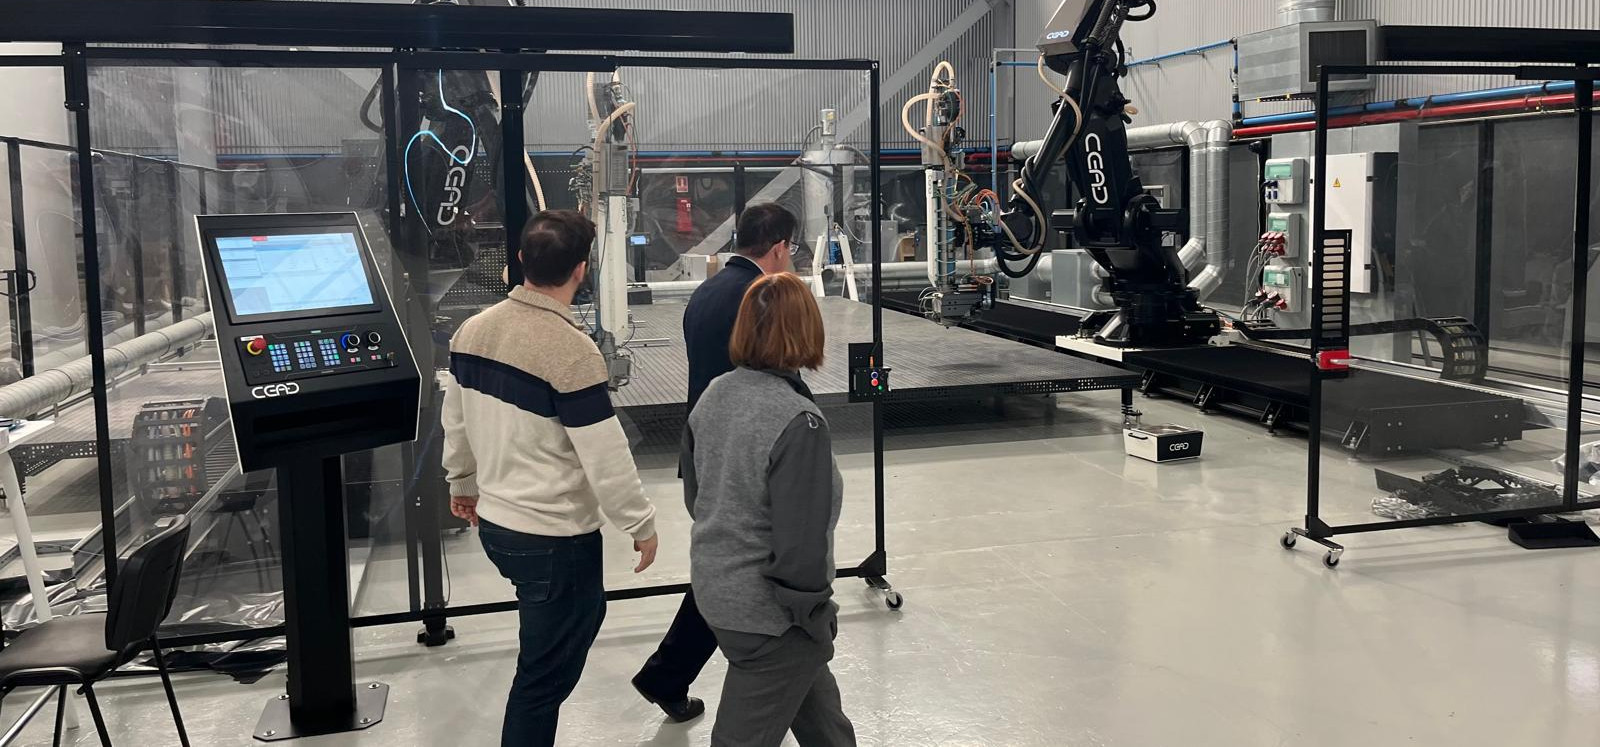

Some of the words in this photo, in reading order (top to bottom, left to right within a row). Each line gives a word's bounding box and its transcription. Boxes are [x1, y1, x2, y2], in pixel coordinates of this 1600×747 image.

[437, 145, 470, 225] CEAD
[1085, 132, 1109, 204] CEAD
[251, 382, 300, 399] CEAD
[1169, 442, 1190, 451] CEAD
